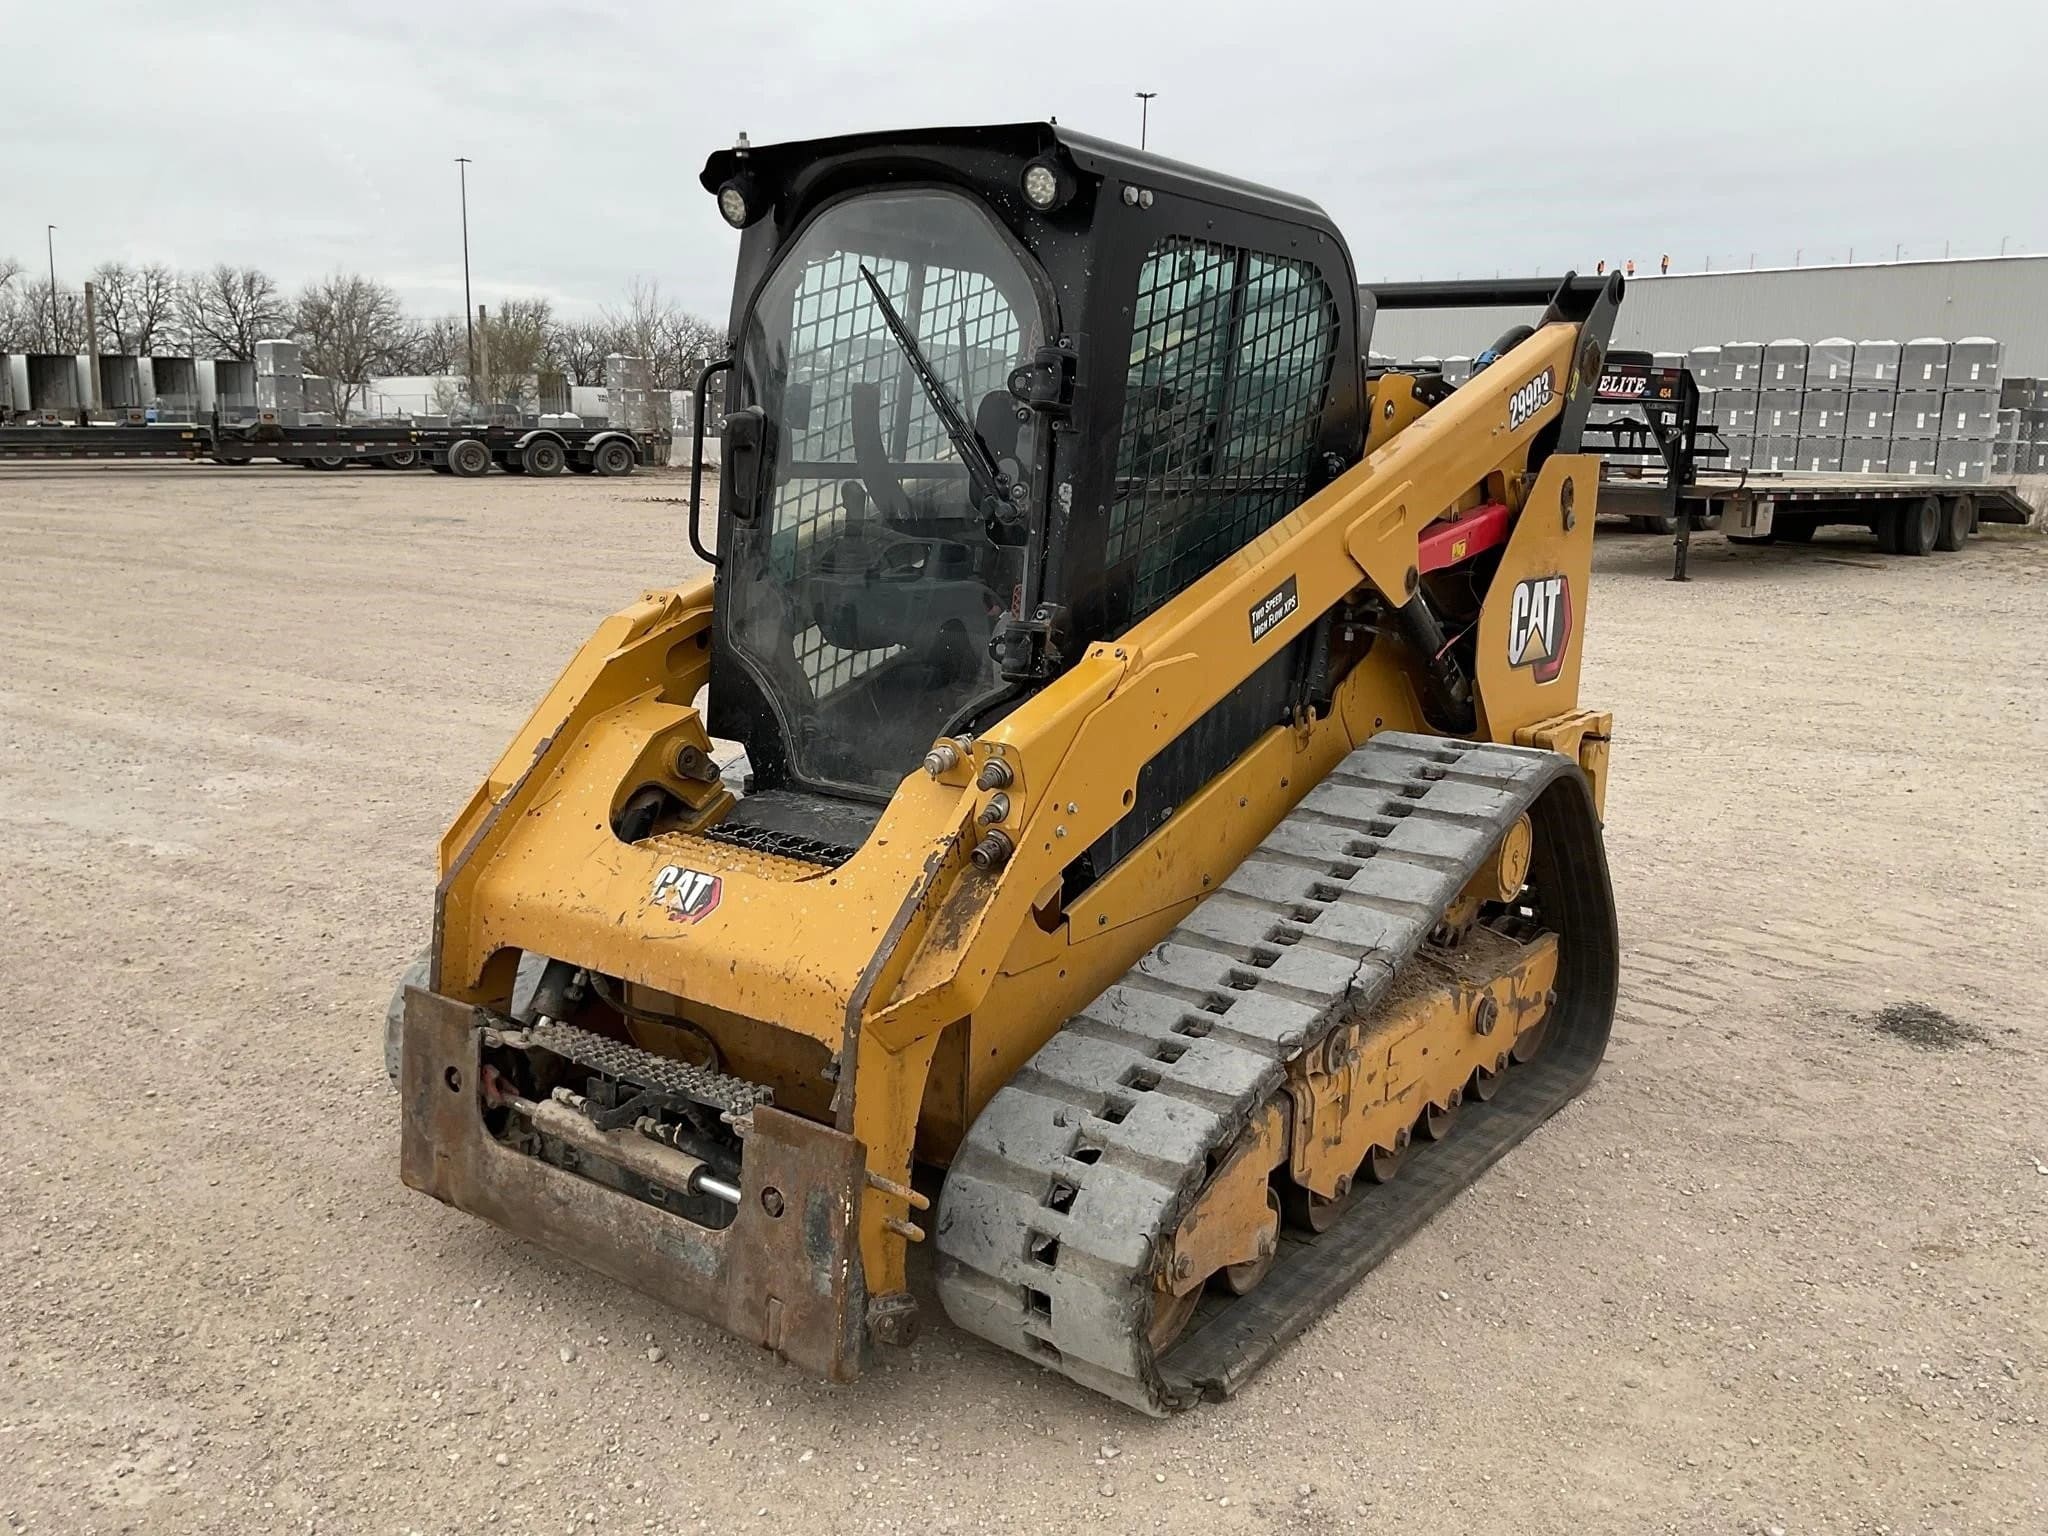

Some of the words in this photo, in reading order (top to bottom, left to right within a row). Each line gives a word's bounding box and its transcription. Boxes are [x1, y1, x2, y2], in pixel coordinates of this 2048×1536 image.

[1509, 370, 1550, 431] 299D3
[1597, 375, 1647, 395] ELITE
[1284, 593, 1297, 615] XPS
[1508, 578, 1562, 666] CAT
[653, 865, 716, 913] CAT
